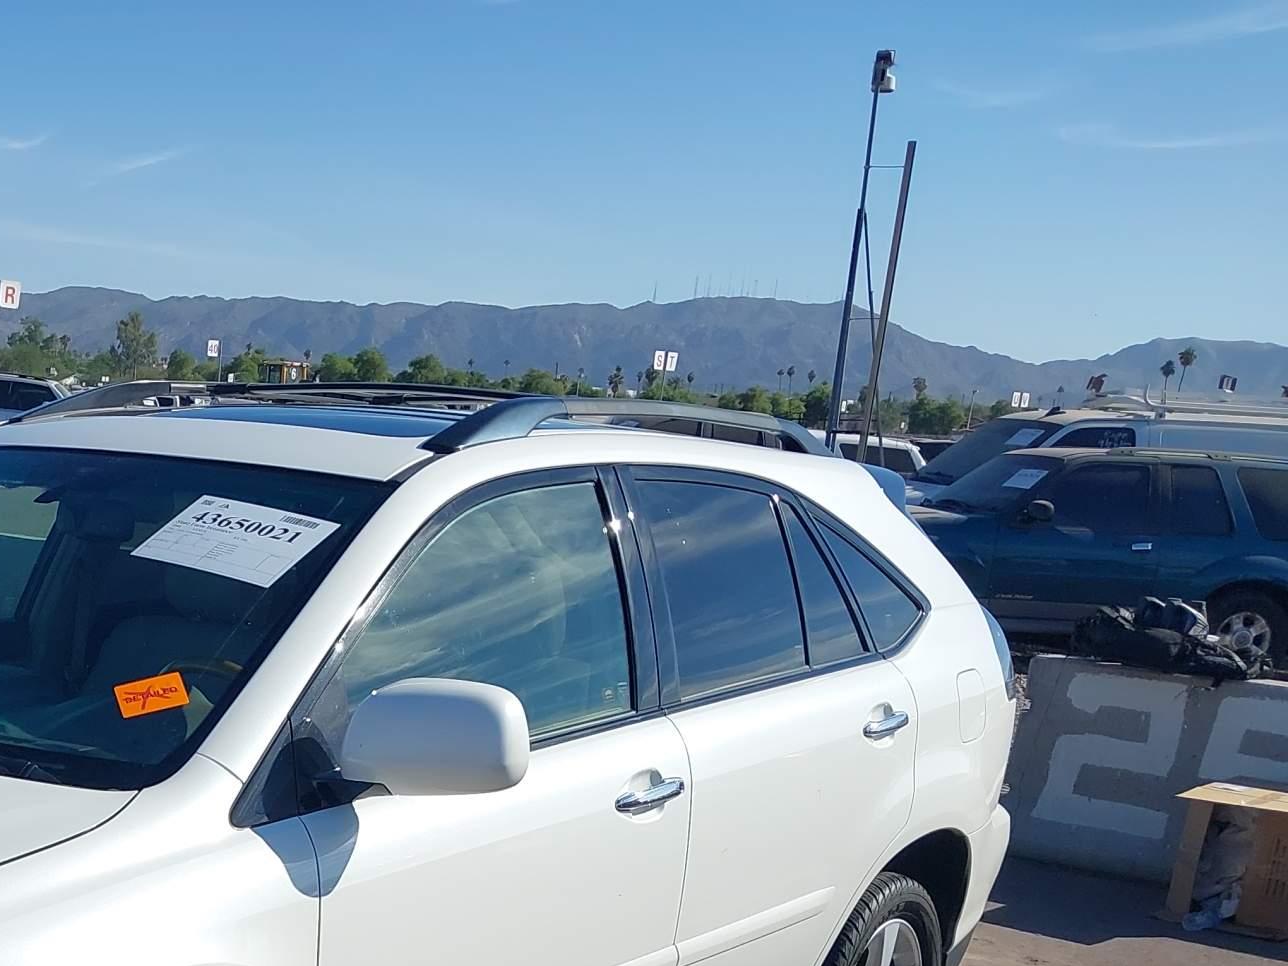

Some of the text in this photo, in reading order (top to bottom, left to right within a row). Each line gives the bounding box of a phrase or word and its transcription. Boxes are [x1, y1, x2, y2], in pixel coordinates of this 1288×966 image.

[4, 286, 16, 304] R
[657, 355, 675, 368] S T
[191, 511, 303, 544] 43650021
